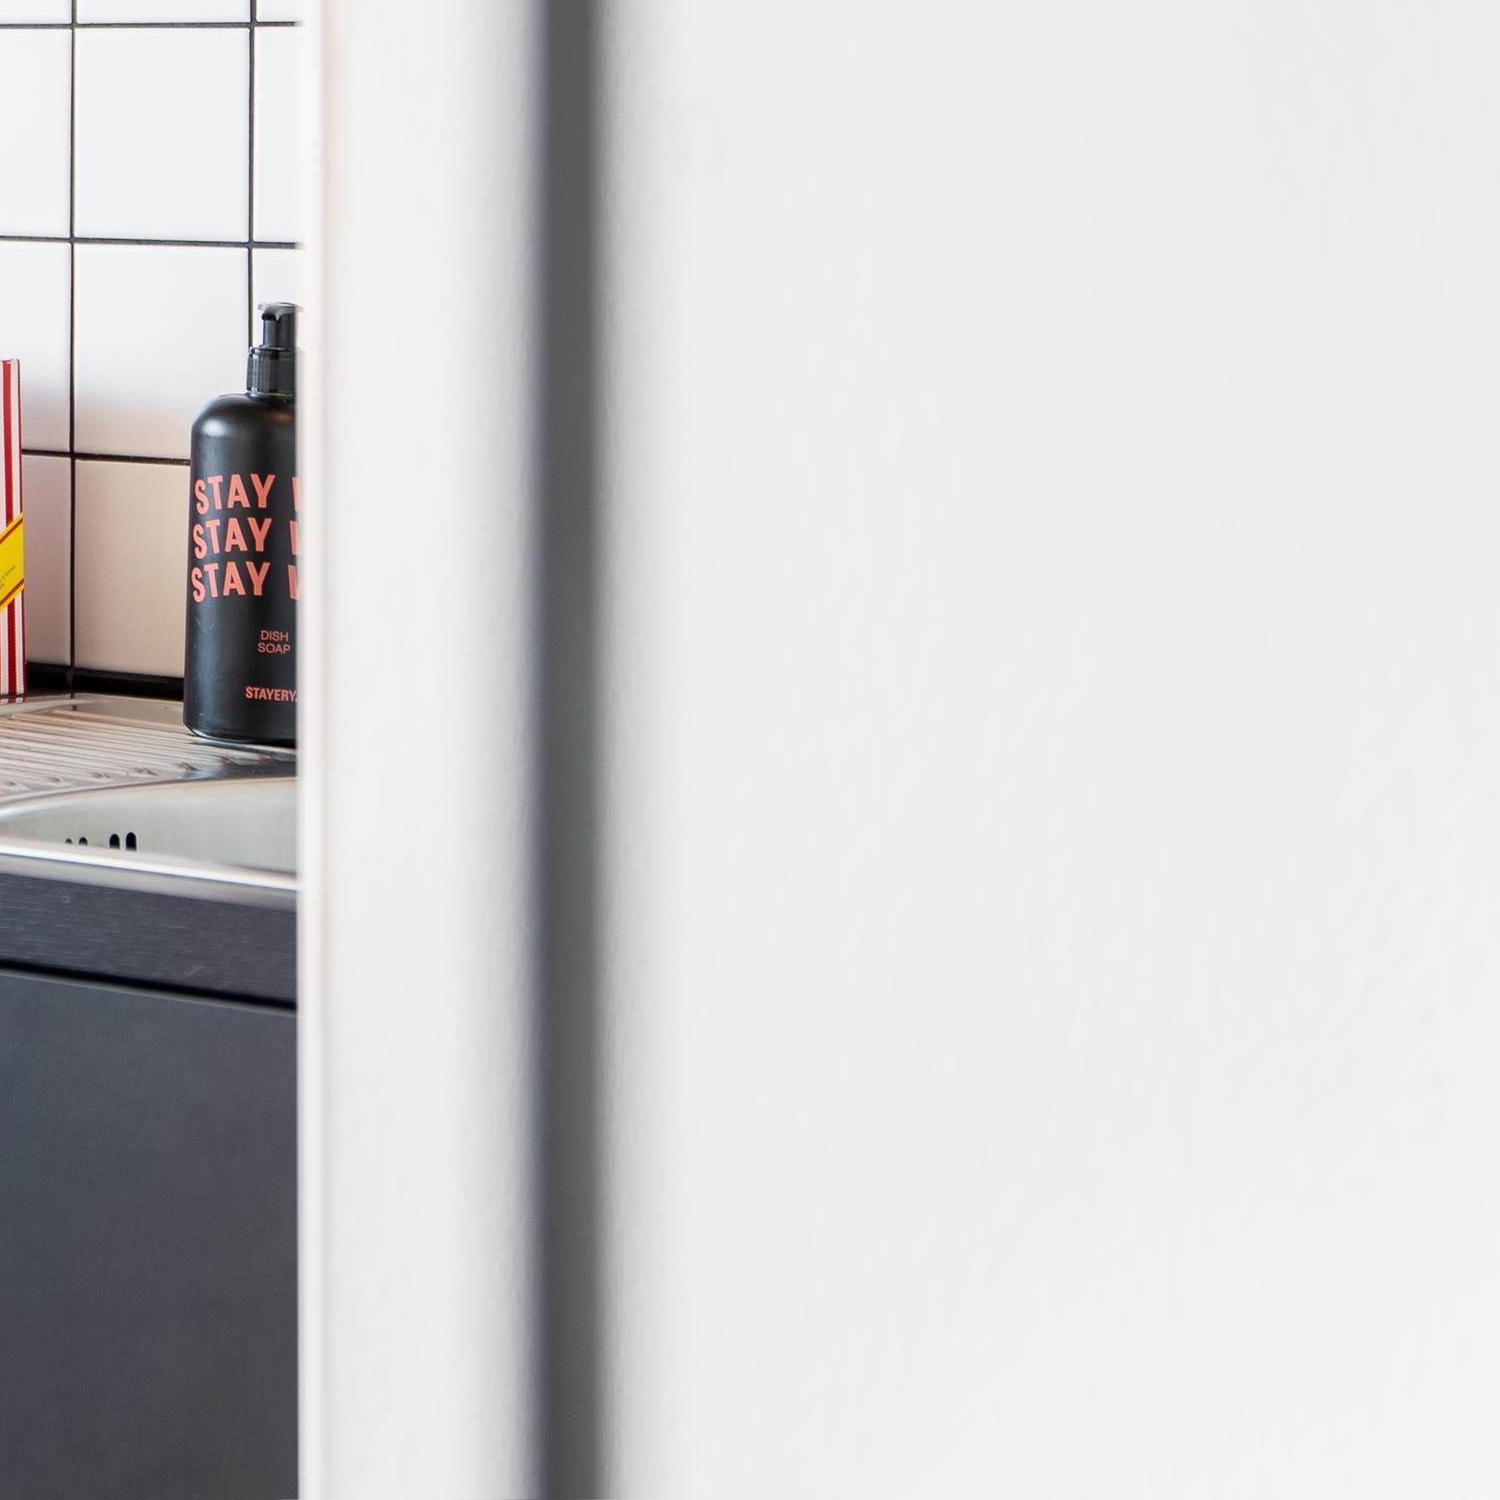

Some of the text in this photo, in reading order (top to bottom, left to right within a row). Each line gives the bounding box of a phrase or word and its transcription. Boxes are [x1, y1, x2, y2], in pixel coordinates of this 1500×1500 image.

[194, 473, 276, 515] STAY
[192, 517, 273, 560] STAY
[190, 561, 271, 603] STAY
[257, 642, 291, 654] SOAP
[260, 629, 289, 642] DISH
